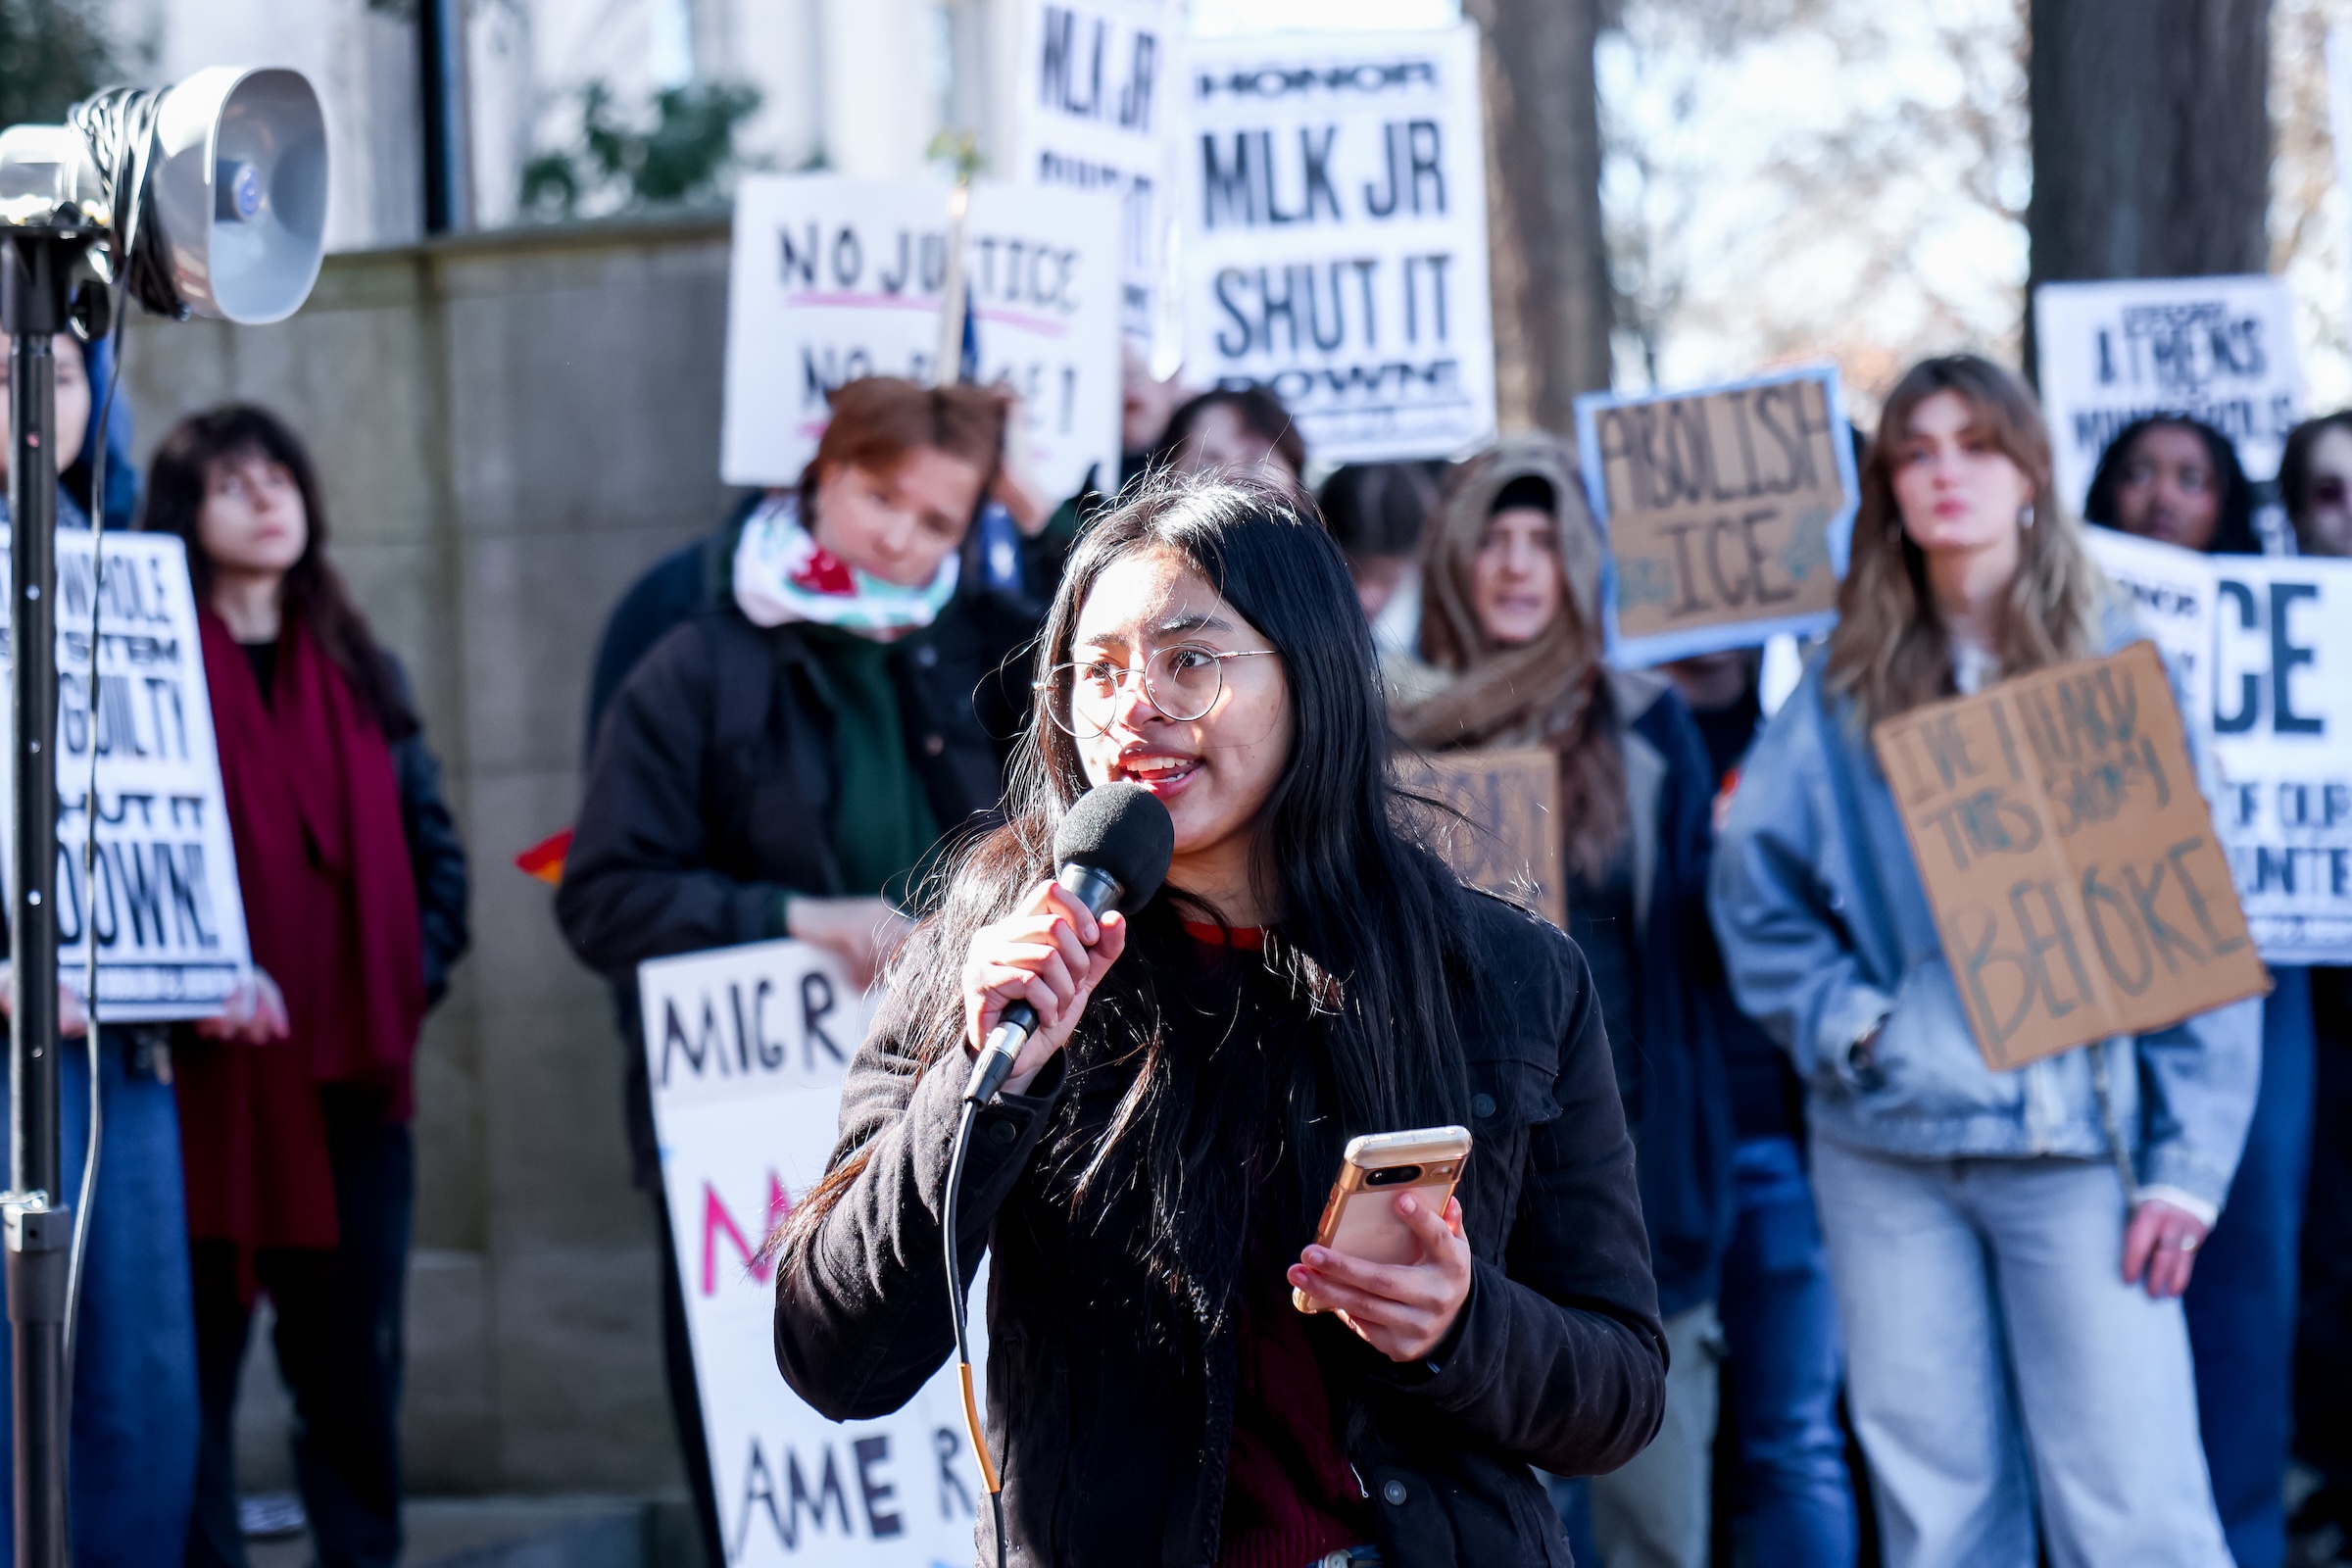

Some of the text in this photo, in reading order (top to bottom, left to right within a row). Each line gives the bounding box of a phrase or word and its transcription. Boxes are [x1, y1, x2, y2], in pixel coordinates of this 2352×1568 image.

[1198, 61, 1441, 99] HONOR
[1201, 124, 1345, 232] MLK
[1364, 120, 1450, 220] JR
[778, 223, 863, 289] NO
[882, 228, 1081, 314] JUTICE
[1213, 253, 1454, 363] SHUT IT
[1658, 508, 1797, 617] ICE
[2213, 578, 2325, 734] CE
[56, 790, 155, 829] HUT
[662, 970, 847, 1088] MIGR
[729, 1427, 974, 1562] AMER
